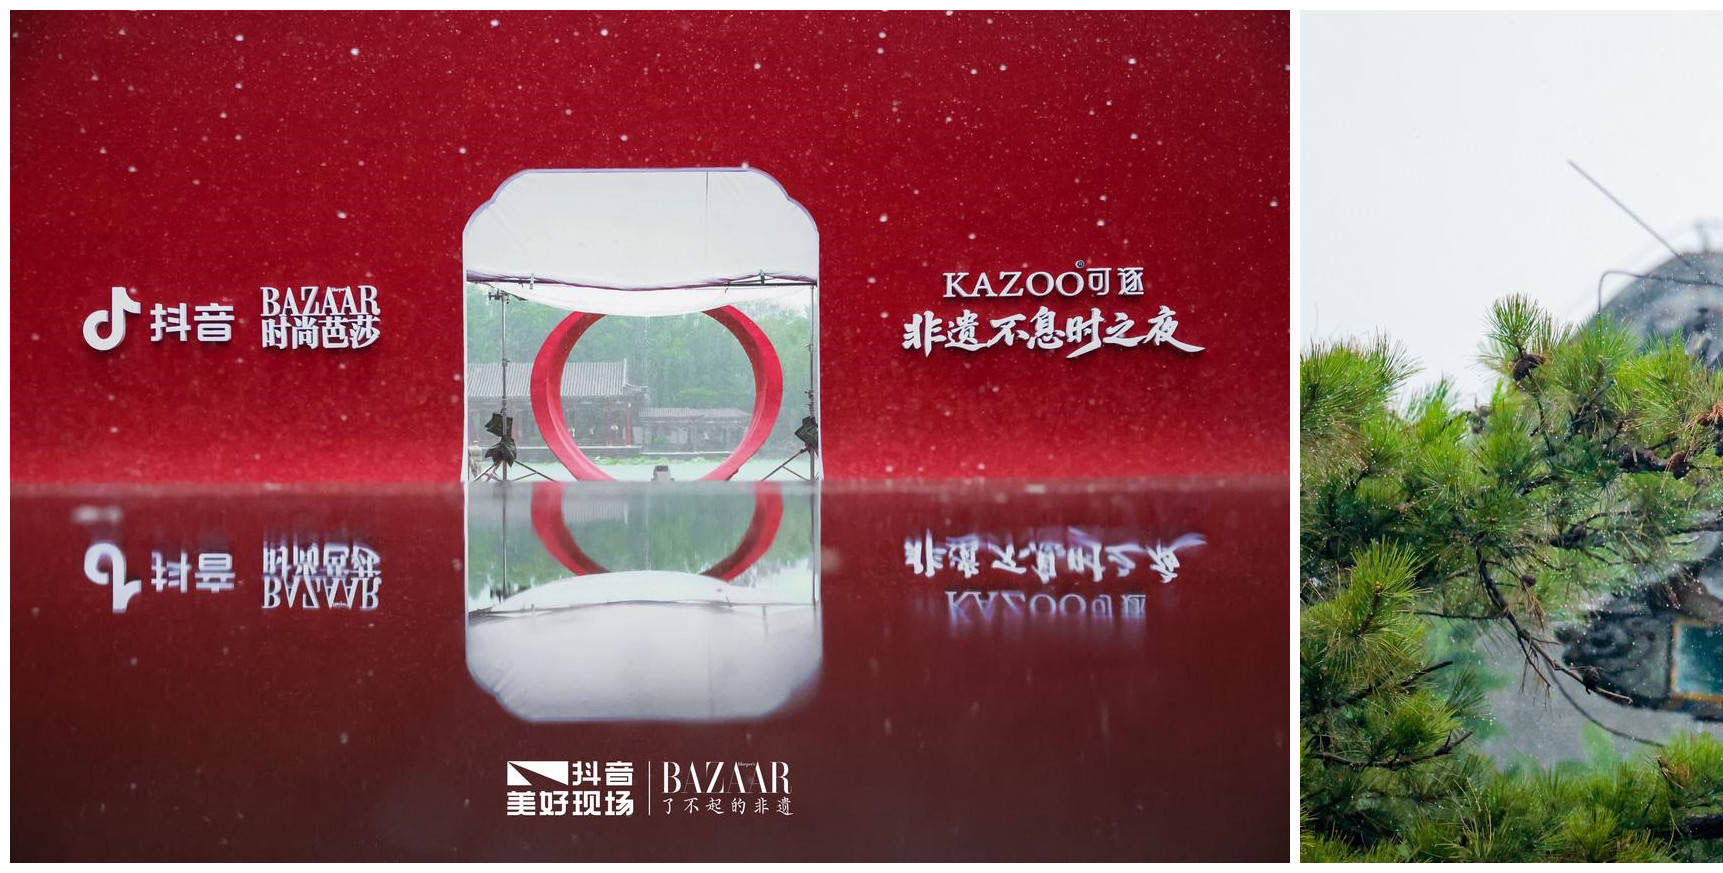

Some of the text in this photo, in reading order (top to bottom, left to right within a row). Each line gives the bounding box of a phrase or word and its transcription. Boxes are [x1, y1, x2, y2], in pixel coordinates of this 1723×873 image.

[942, 267, 1145, 298] KAZOO 可逐
[260, 285, 381, 317] BAZAAR
[150, 302, 235, 342] 抖音
[262, 315, 381, 349] 时尚芭莎
[901, 305, 1206, 358] 非遗不息时之夜
